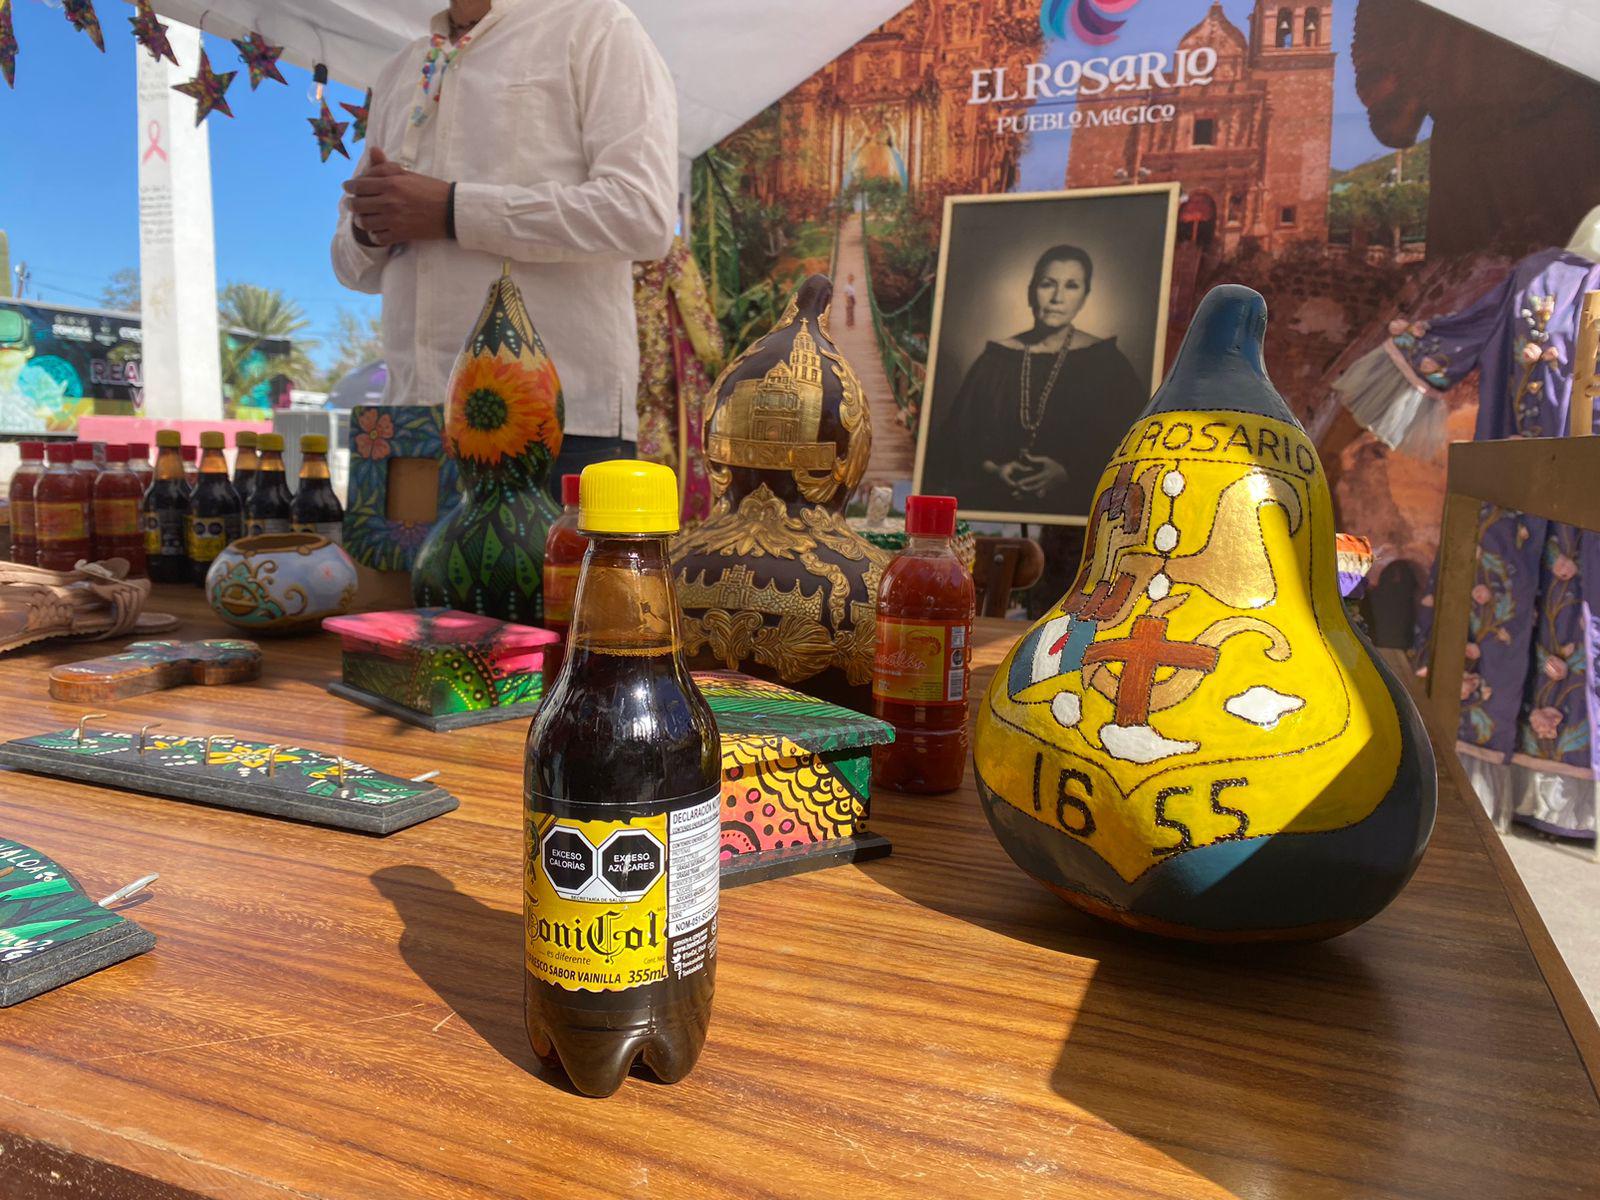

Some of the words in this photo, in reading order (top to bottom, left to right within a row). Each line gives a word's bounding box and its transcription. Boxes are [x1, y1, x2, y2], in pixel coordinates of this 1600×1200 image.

[967, 66, 1019, 105] EL
[552, 848, 582, 860] EXCESO
[613, 852, 651, 863] EXCESO
[549, 857, 586, 871] CALORÍAS
[608, 861, 655, 873] AZÚCARES
[546, 950, 554, 958] es
[555, 951, 592, 966] diferente
[549, 965, 575, 981] SABOR
[577, 972, 621, 984] VAINILLA
[627, 965, 667, 984] 355mL
